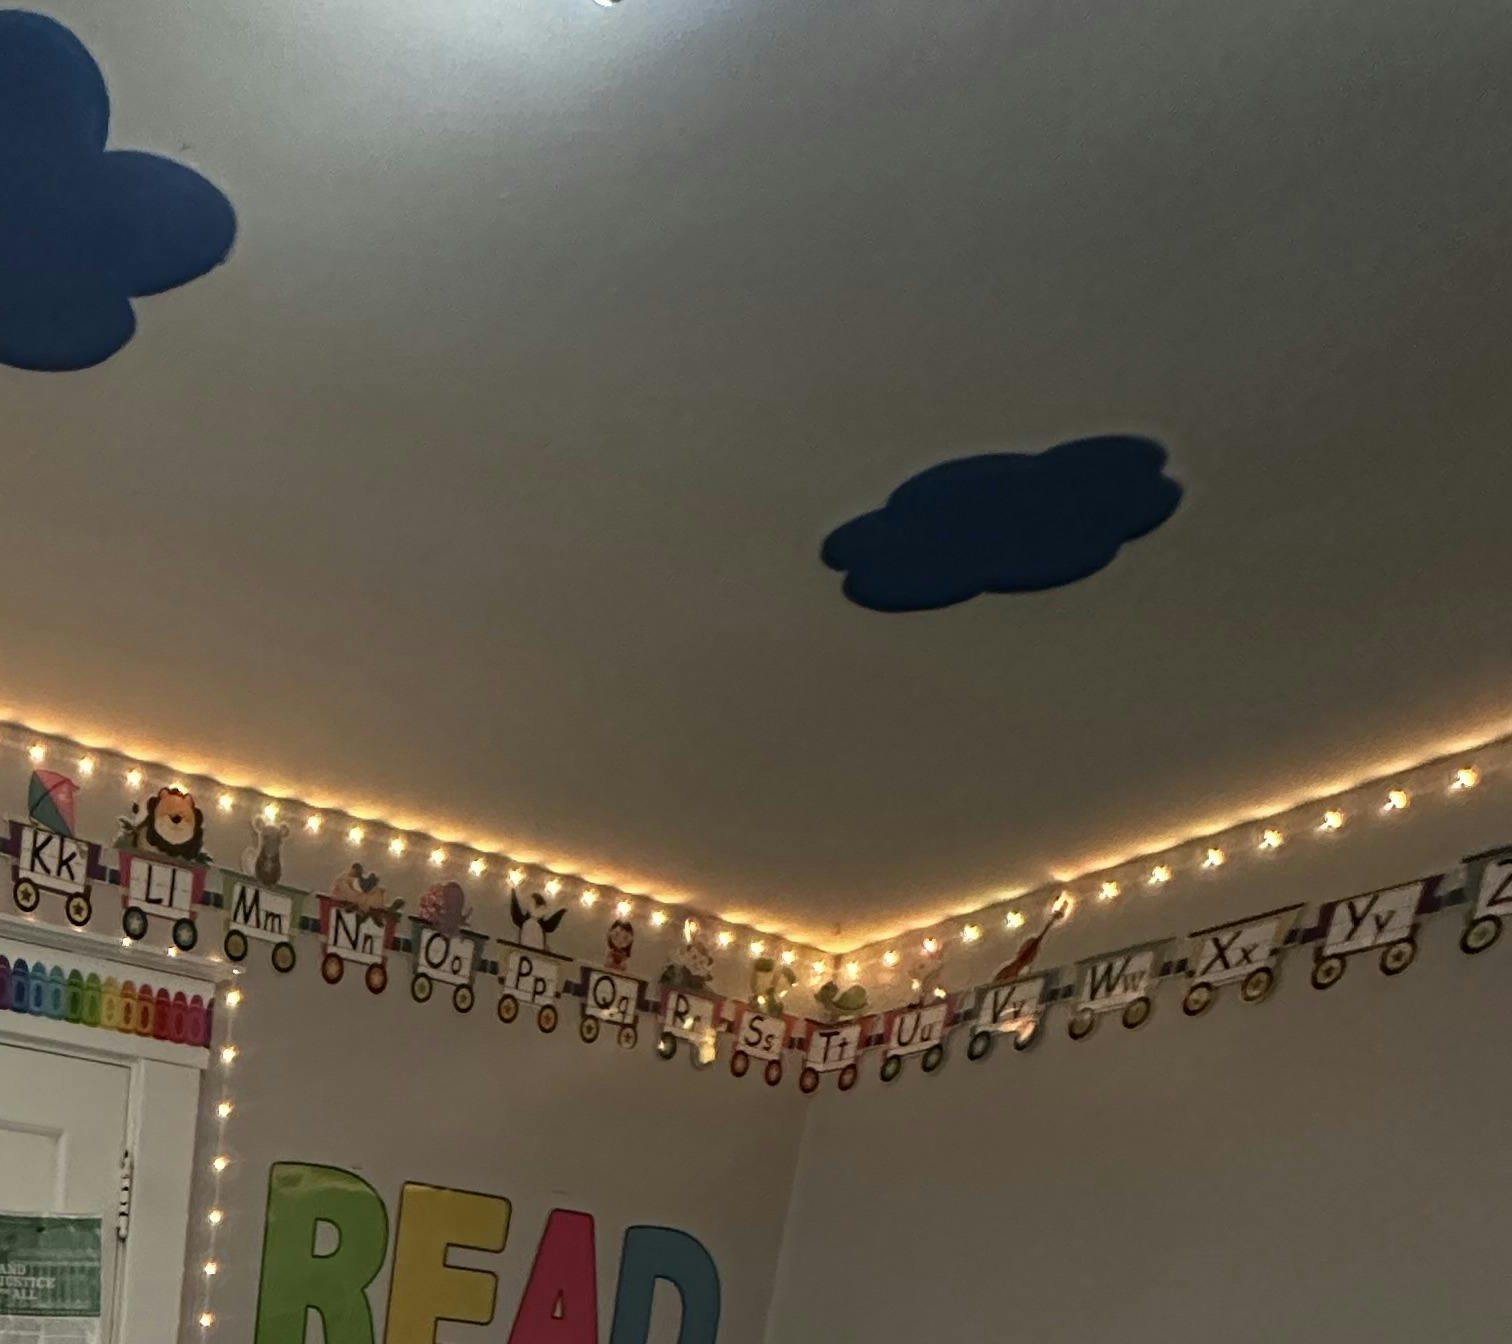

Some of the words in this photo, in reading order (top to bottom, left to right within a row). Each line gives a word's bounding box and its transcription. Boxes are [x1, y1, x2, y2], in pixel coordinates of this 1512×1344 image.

[29, 828, 77, 882] Kk
[231, 886, 282, 934] Mm
[333, 912, 374, 955] Nn
[424, 931, 462, 975] Oo
[516, 955, 548, 1004] Pp
[744, 1015, 774, 1051] Ss
[809, 1031, 850, 1063] Tt
[897, 1014, 934, 1047] Uu
[1090, 955, 1146, 1001] Ww
[1200, 931, 1258, 976] Xx
[1344, 893, 1397, 941] Yy
[12, 1288, 38, 1301] ALL
